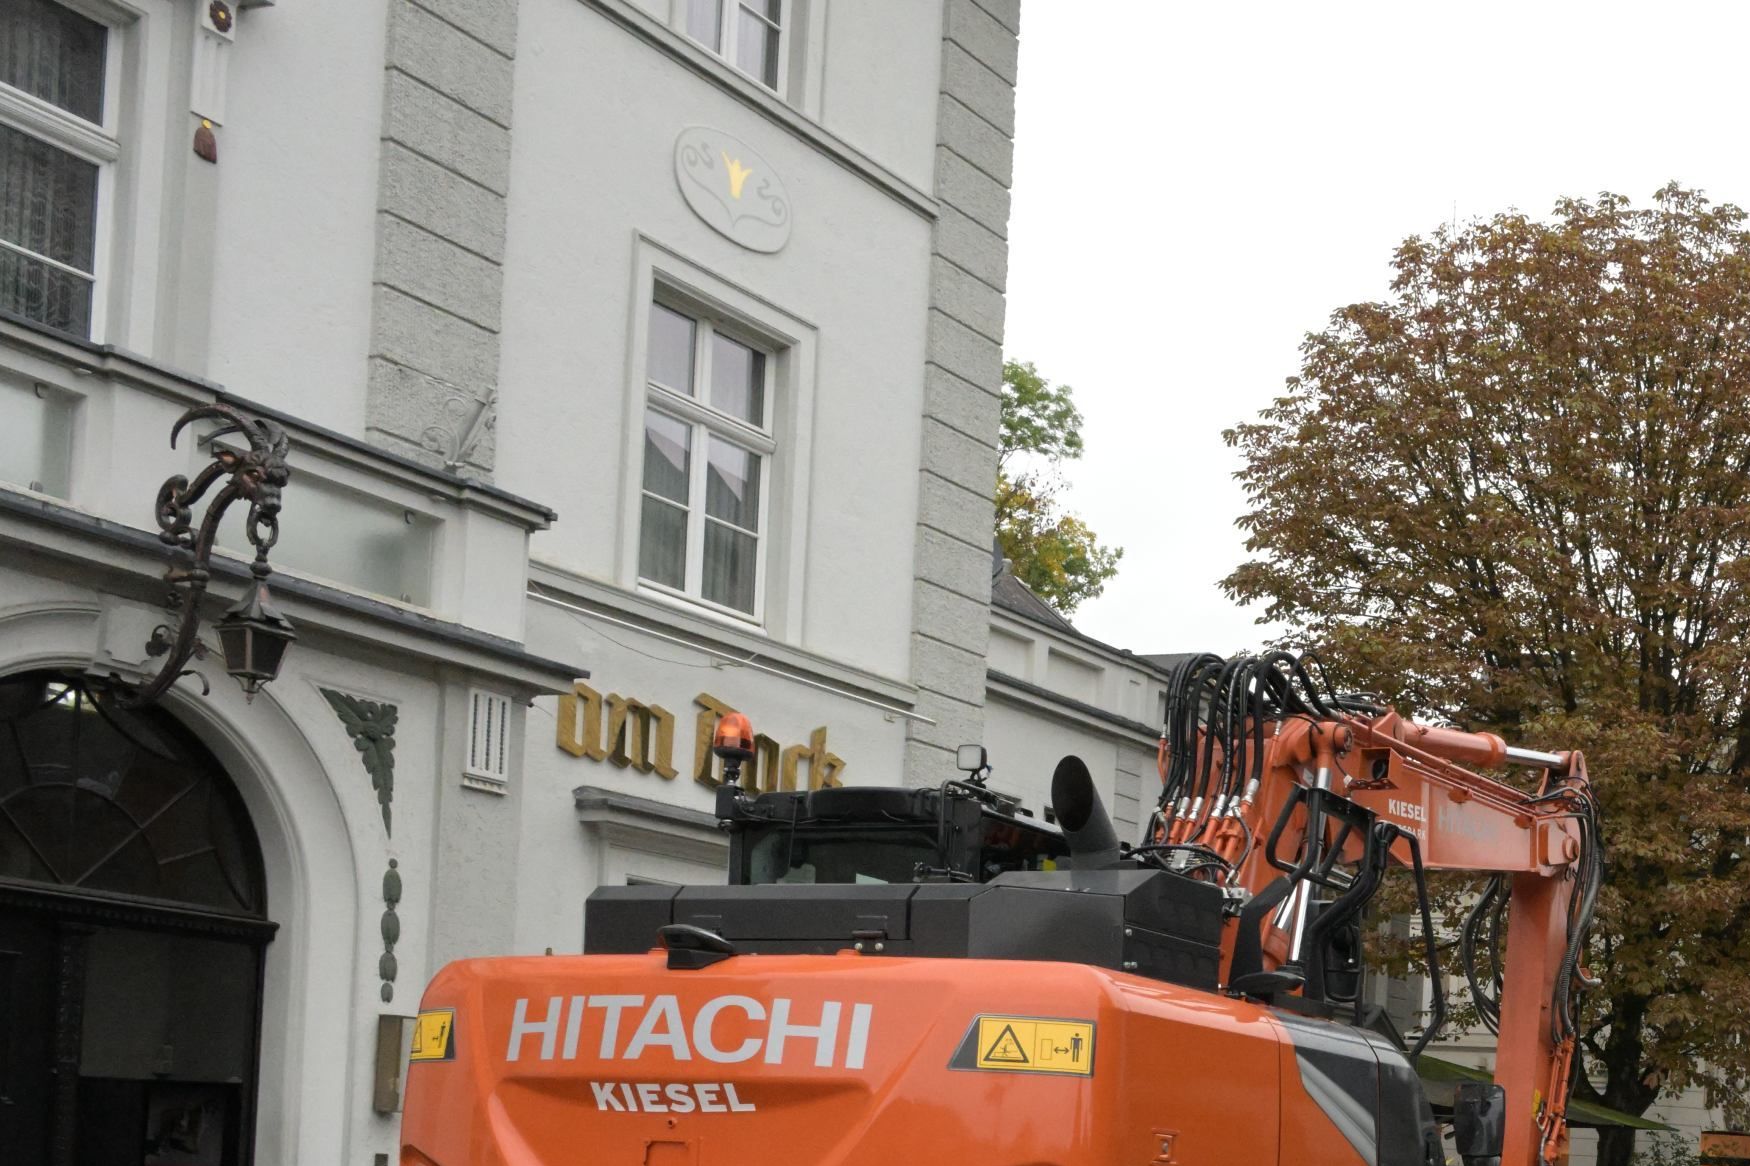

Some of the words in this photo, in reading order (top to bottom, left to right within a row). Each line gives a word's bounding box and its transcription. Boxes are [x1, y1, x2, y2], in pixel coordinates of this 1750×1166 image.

[1388, 799, 1427, 821] KIESEL
[506, 995, 872, 1069] HITACHI
[590, 1082, 756, 1112] KIESEL
